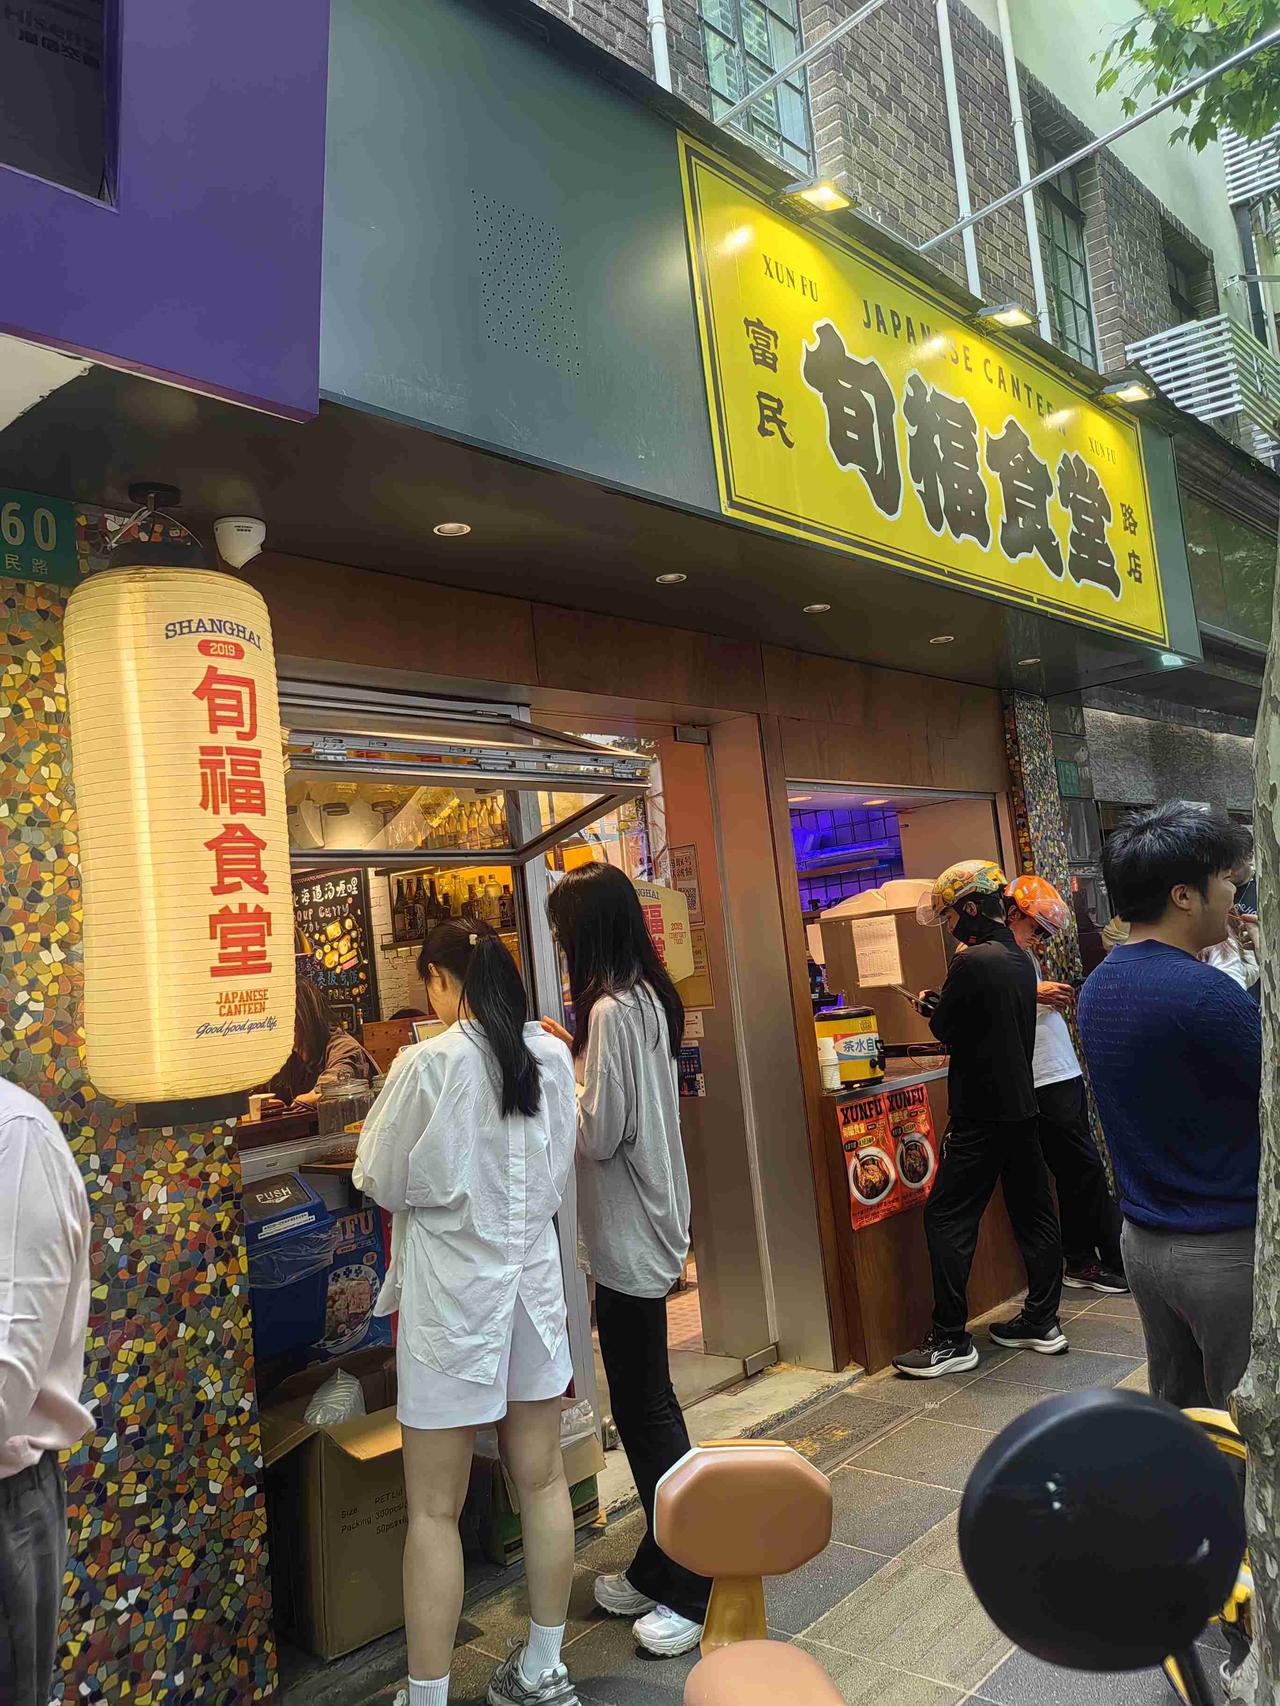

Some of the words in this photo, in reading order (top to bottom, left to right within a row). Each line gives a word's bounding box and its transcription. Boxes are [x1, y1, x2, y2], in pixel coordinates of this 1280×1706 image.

[762, 254, 797, 290] XUN
[800, 274, 820, 303] FU
[862, 299, 974, 373] JAPANSE
[743, 316, 795, 449] 富民
[802, 318, 1123, 602] 旬福食堂
[1088, 436, 1106, 460] XUN
[1107, 447, 1118, 466] FU
[1119, 502, 1143, 585] 路店
[5, 553, 48, 575] 民路
[164, 618, 262, 652] SHANGHAI
[209, 642, 237, 657] 2019
[191, 664, 273, 978] 旬福食堂
[216, 988, 269, 1005] JAPANESE
[218, 1001, 267, 1018] CANTEEN
[843, 1037, 878, 1053] 茶水自
[840, 1098, 883, 1126] XUNFU
[887, 1086, 924, 1112] XUNFU
[255, 1186, 292, 1203] PUSH
